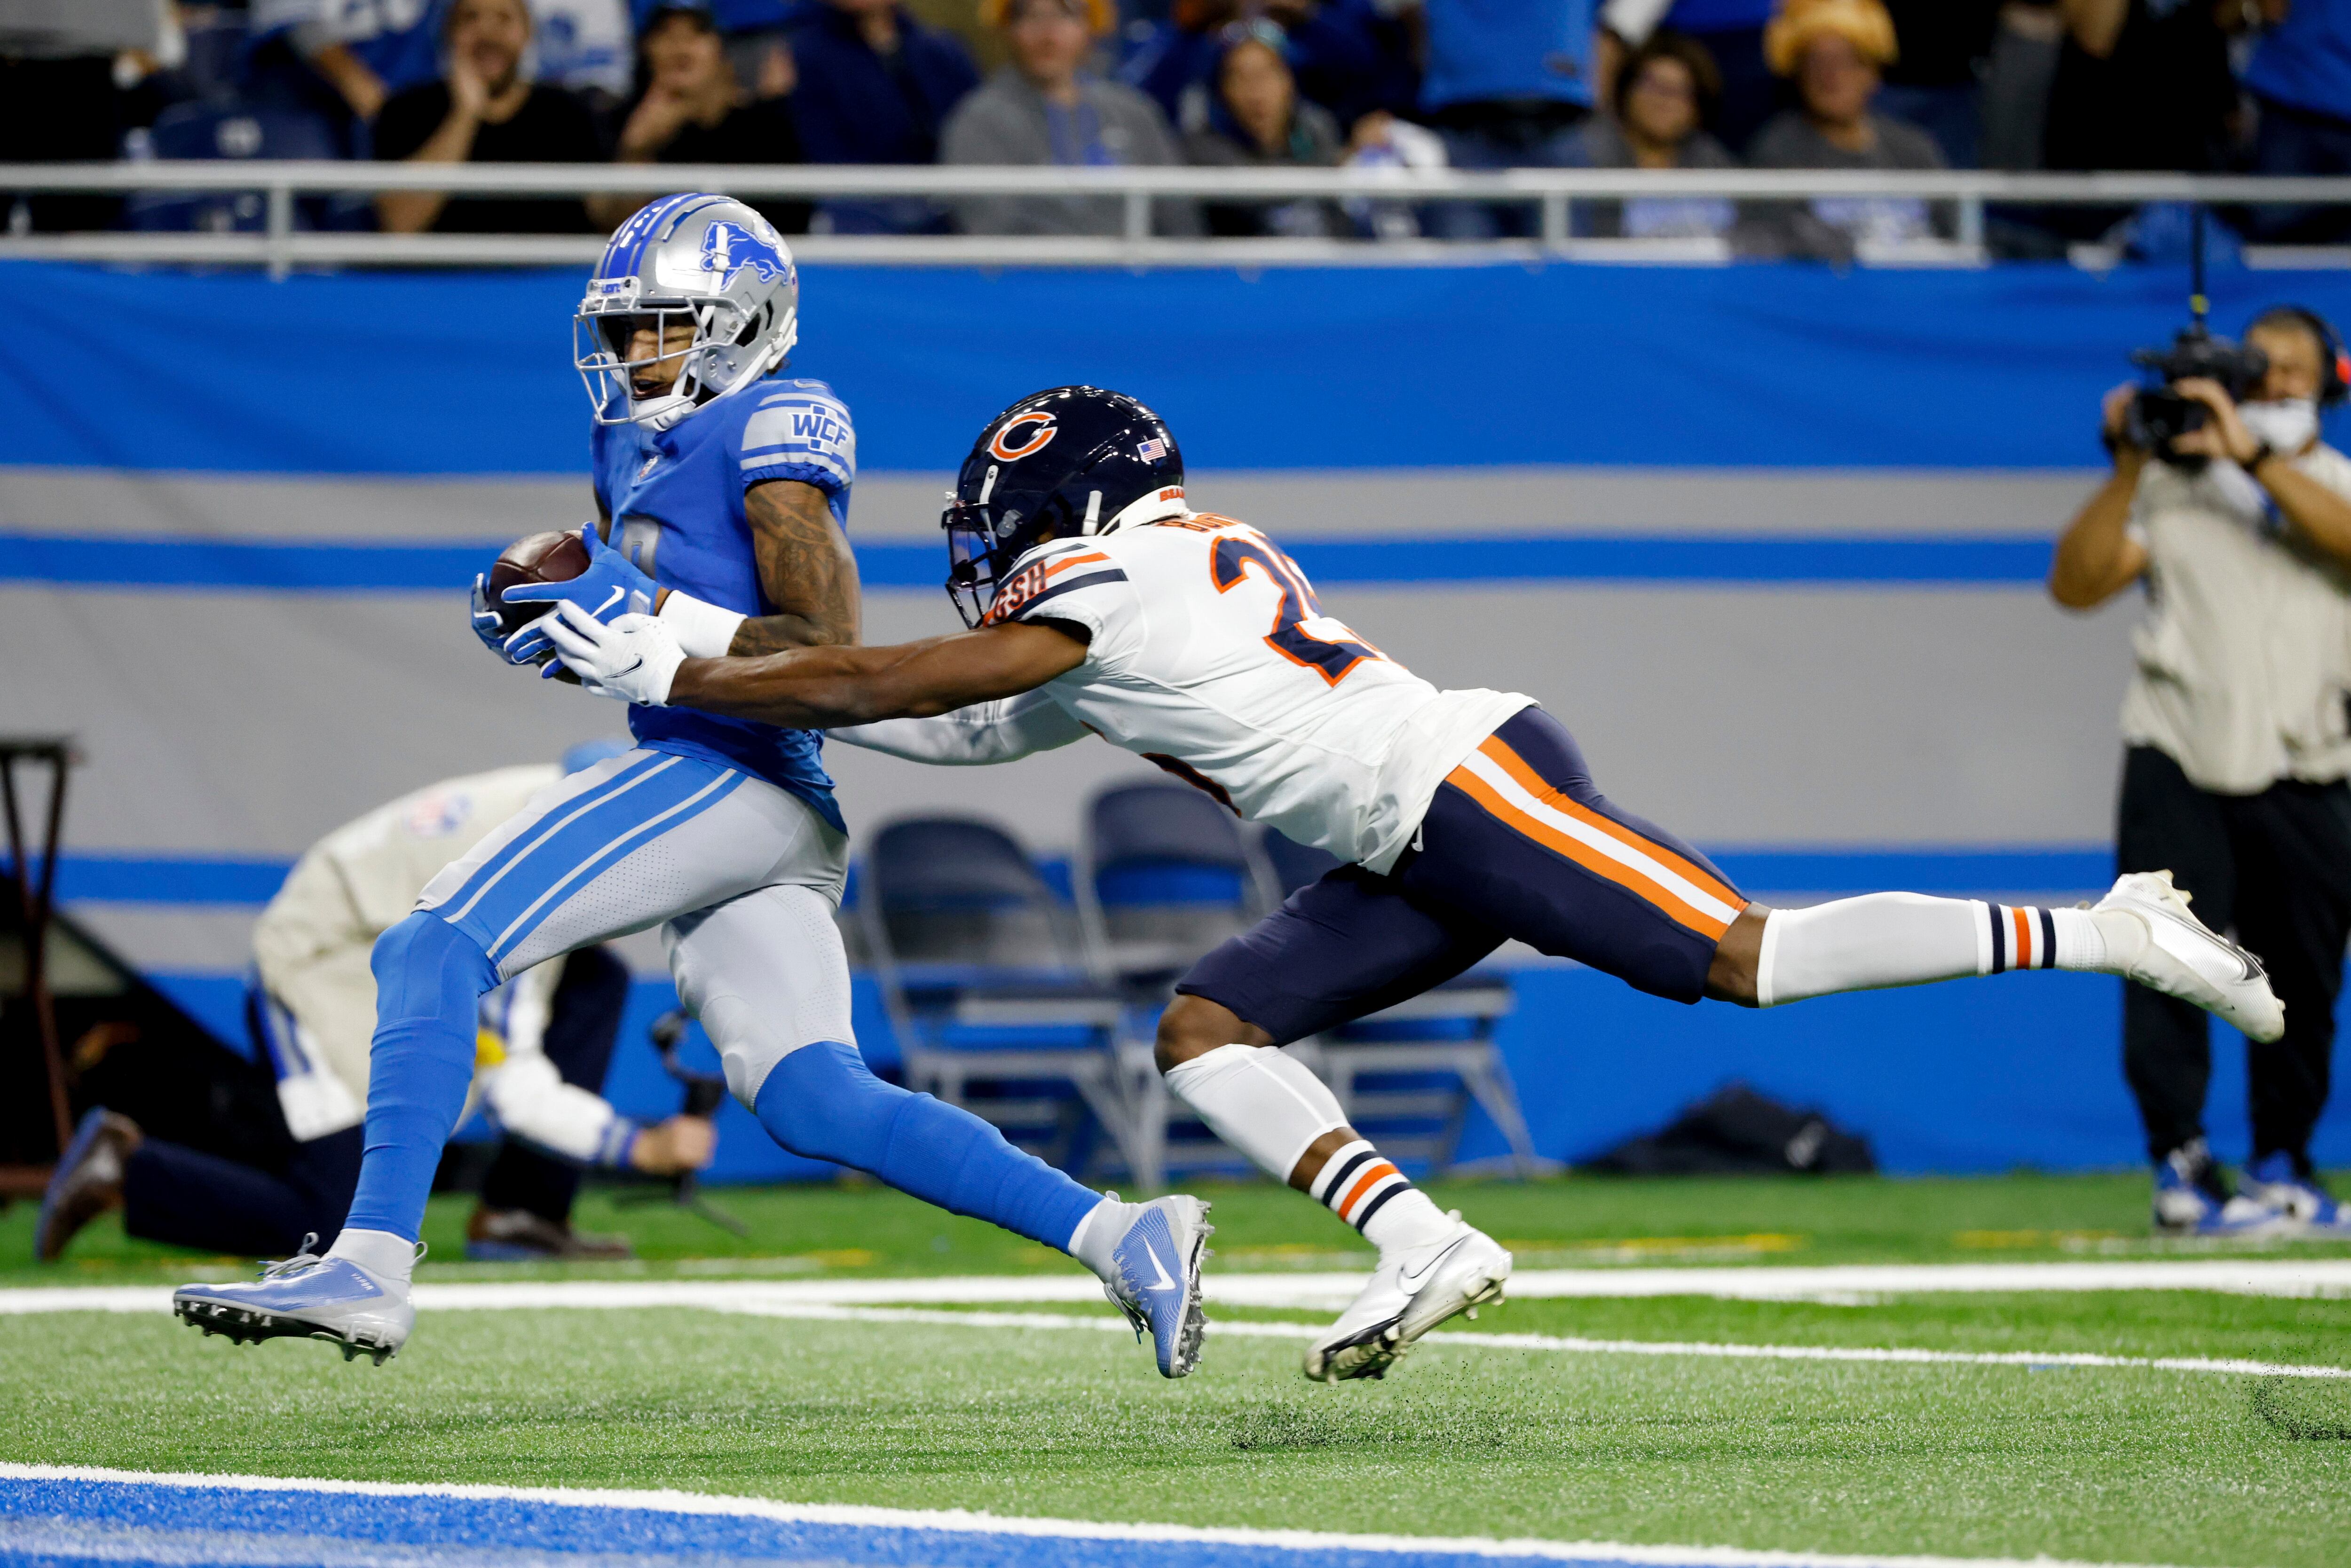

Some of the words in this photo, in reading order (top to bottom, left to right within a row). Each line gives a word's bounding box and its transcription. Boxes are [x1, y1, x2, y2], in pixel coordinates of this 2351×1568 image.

[791, 414, 849, 447] WCF
[994, 559, 1047, 622] GSH
[1210, 531, 1407, 688] 2
[349, 1273, 375, 1291] VAPOR
